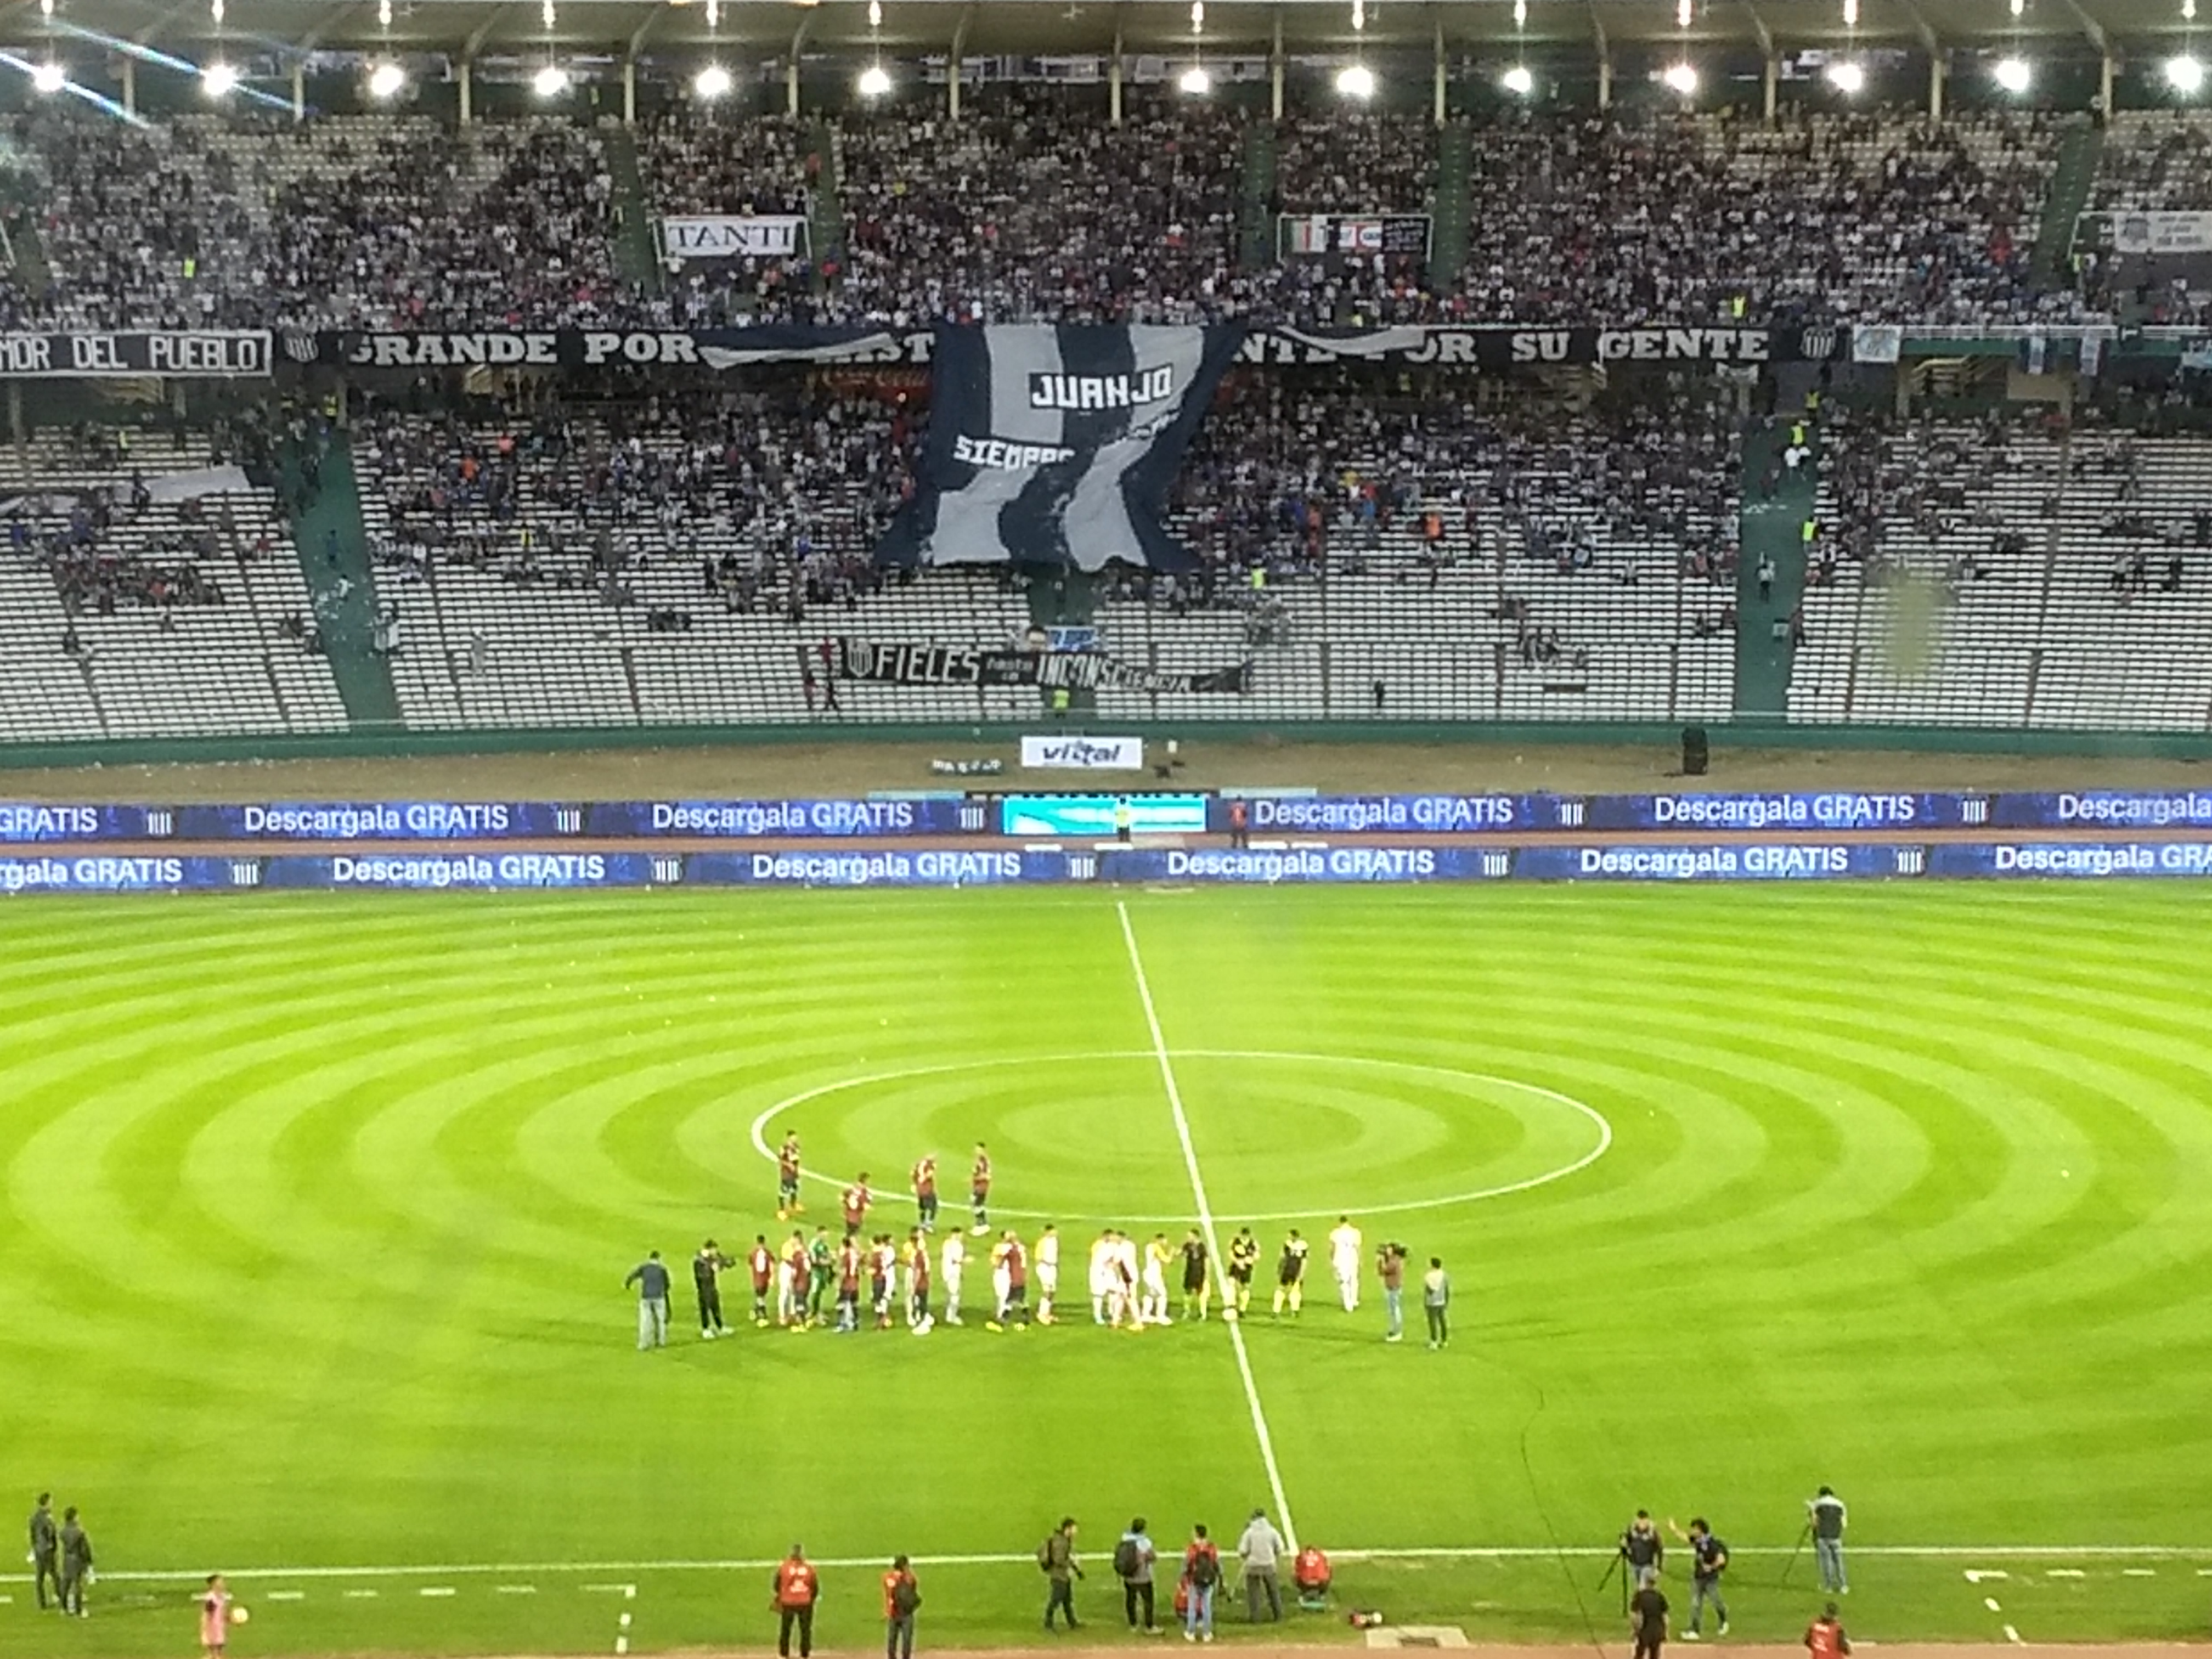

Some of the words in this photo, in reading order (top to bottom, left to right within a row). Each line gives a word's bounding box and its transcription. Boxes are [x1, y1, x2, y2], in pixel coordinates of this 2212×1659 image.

[668, 225, 790, 246] TANTI
[73, 336, 128, 369] DEL
[149, 336, 257, 370] PUEBLO
[585, 333, 697, 364] POR
[1512, 332, 1569, 362] SU
[1598, 331, 1769, 360] GENTE
[1032, 366, 1172, 408] JUANJO
[876, 646, 981, 682] FIELES
[0, 808, 98, 832] GRATIS
[245, 805, 400, 837] Descargala
[407, 805, 509, 831] GRATIS
[653, 802, 805, 833] Descargala
[812, 803, 913, 828] GRATIS
[1256, 798, 1406, 829] Descargala
[1413, 798, 1513, 824] GRATIS
[1655, 795, 1806, 826] Descargala
[1814, 795, 1914, 821] GRATIS
[2059, 792, 2211, 824] Descargala
[75, 859, 183, 883] GRATIS
[334, 856, 493, 885] Descargala
[500, 855, 604, 879] GRATIS
[753, 853, 909, 882] Descargala
[917, 853, 1021, 877] GRATIS
[1168, 849, 1324, 878] Descargala
[1330, 849, 1434, 874] GRATIS
[1581, 847, 1736, 877] Descargala
[1744, 847, 1848, 872] GRATIS
[1996, 845, 2153, 874] Descargala
